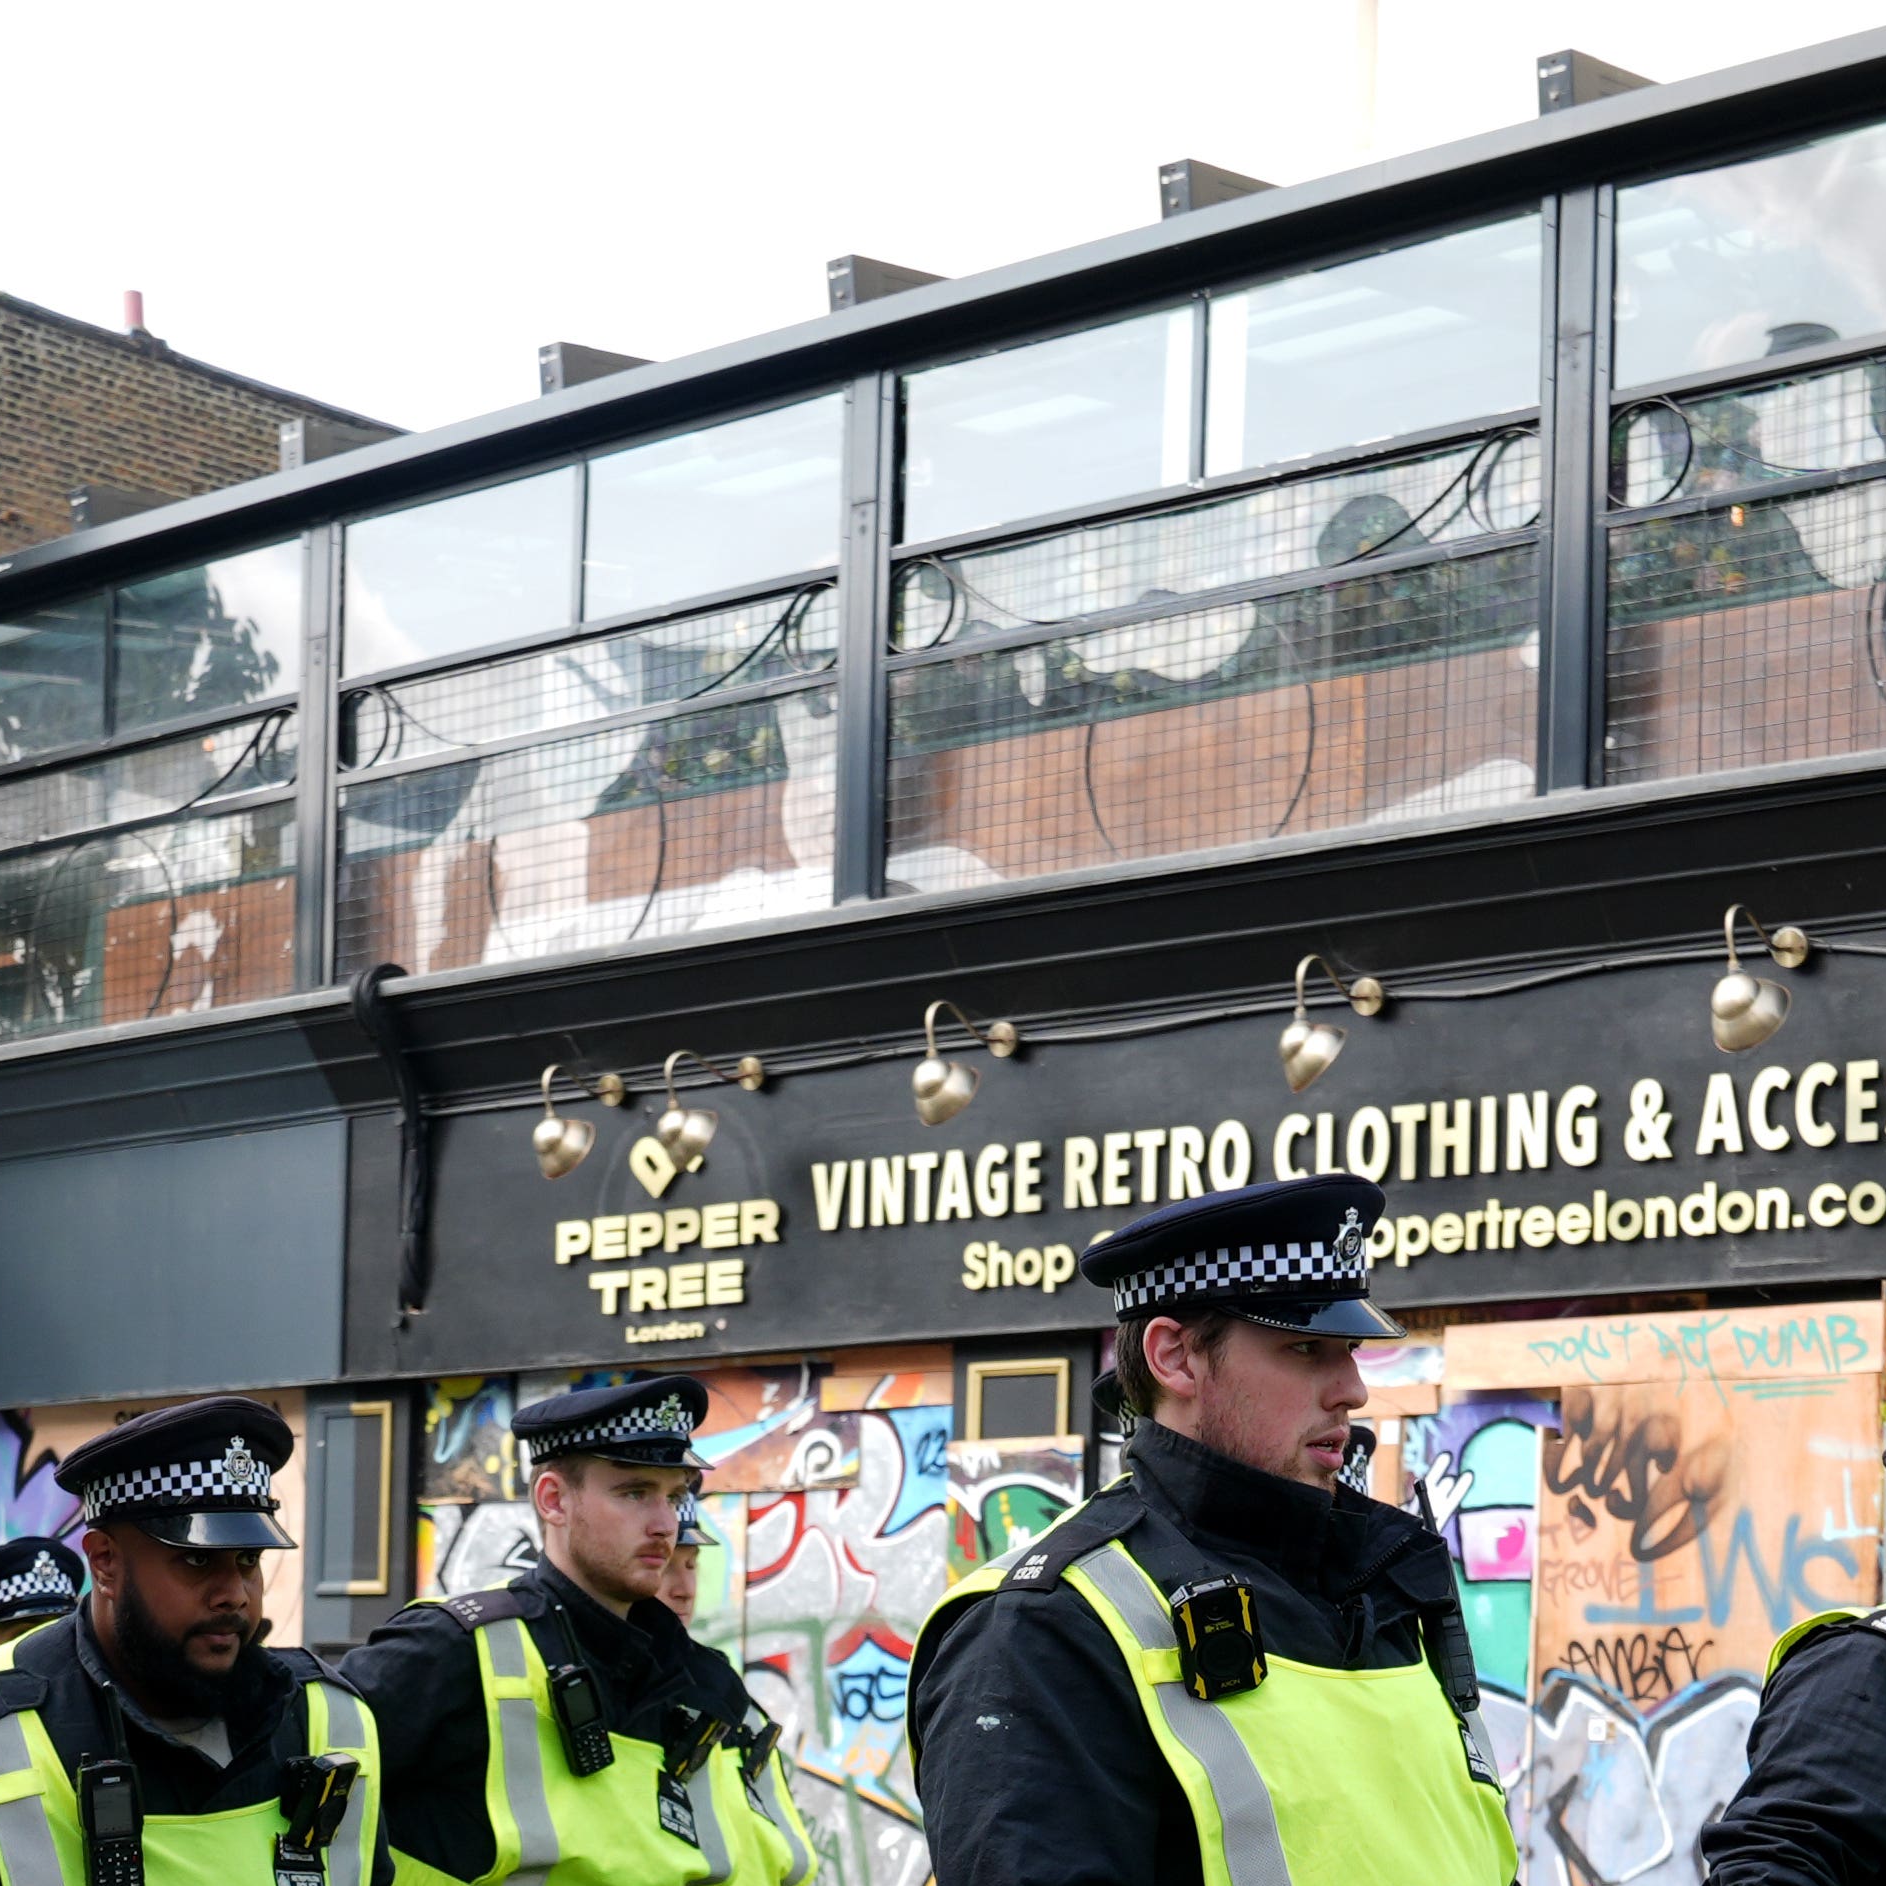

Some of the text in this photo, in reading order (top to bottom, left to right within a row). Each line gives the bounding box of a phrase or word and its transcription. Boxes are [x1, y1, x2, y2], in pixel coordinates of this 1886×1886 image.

[811, 1139, 1043, 1232] VINTAGE
[1063, 1118, 1253, 1211] RETRO
[1273, 1076, 1599, 1185] CLOTHING
[1624, 1077, 1674, 1164] &
[554, 1198, 781, 1265] PEPPER
[588, 1259, 746, 1316] TREE
[961, 1240, 1076, 1293] Shop
[624, 1321, 706, 1345] London
[1732, 1312, 1870, 1373] DUMB
